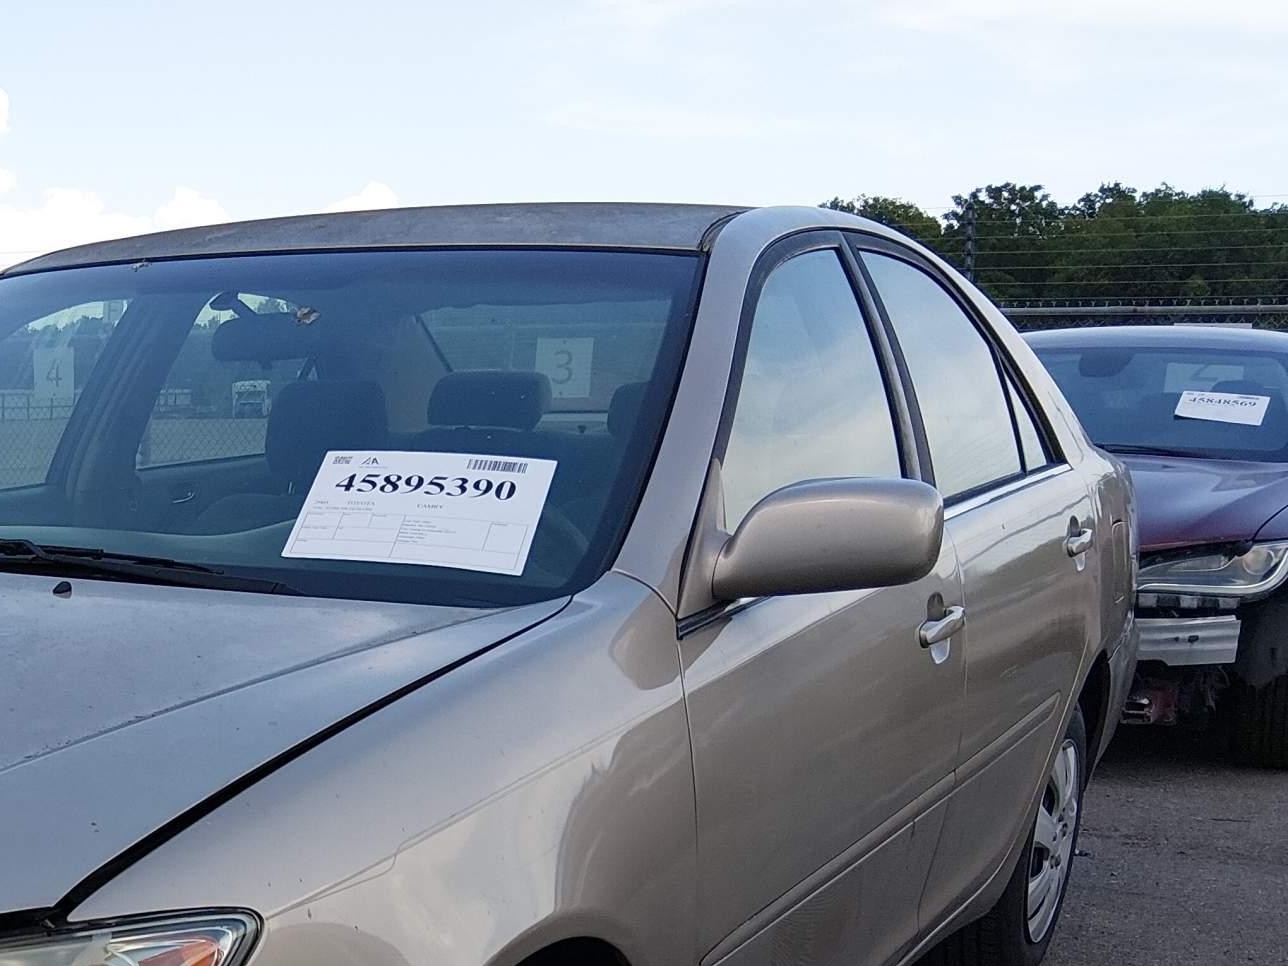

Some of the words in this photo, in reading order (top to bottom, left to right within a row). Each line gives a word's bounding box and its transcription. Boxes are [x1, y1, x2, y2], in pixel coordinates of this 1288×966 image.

[45, 357, 63, 388] 4
[551, 349, 573, 384] 3
[335, 473, 517, 501] 45895390
